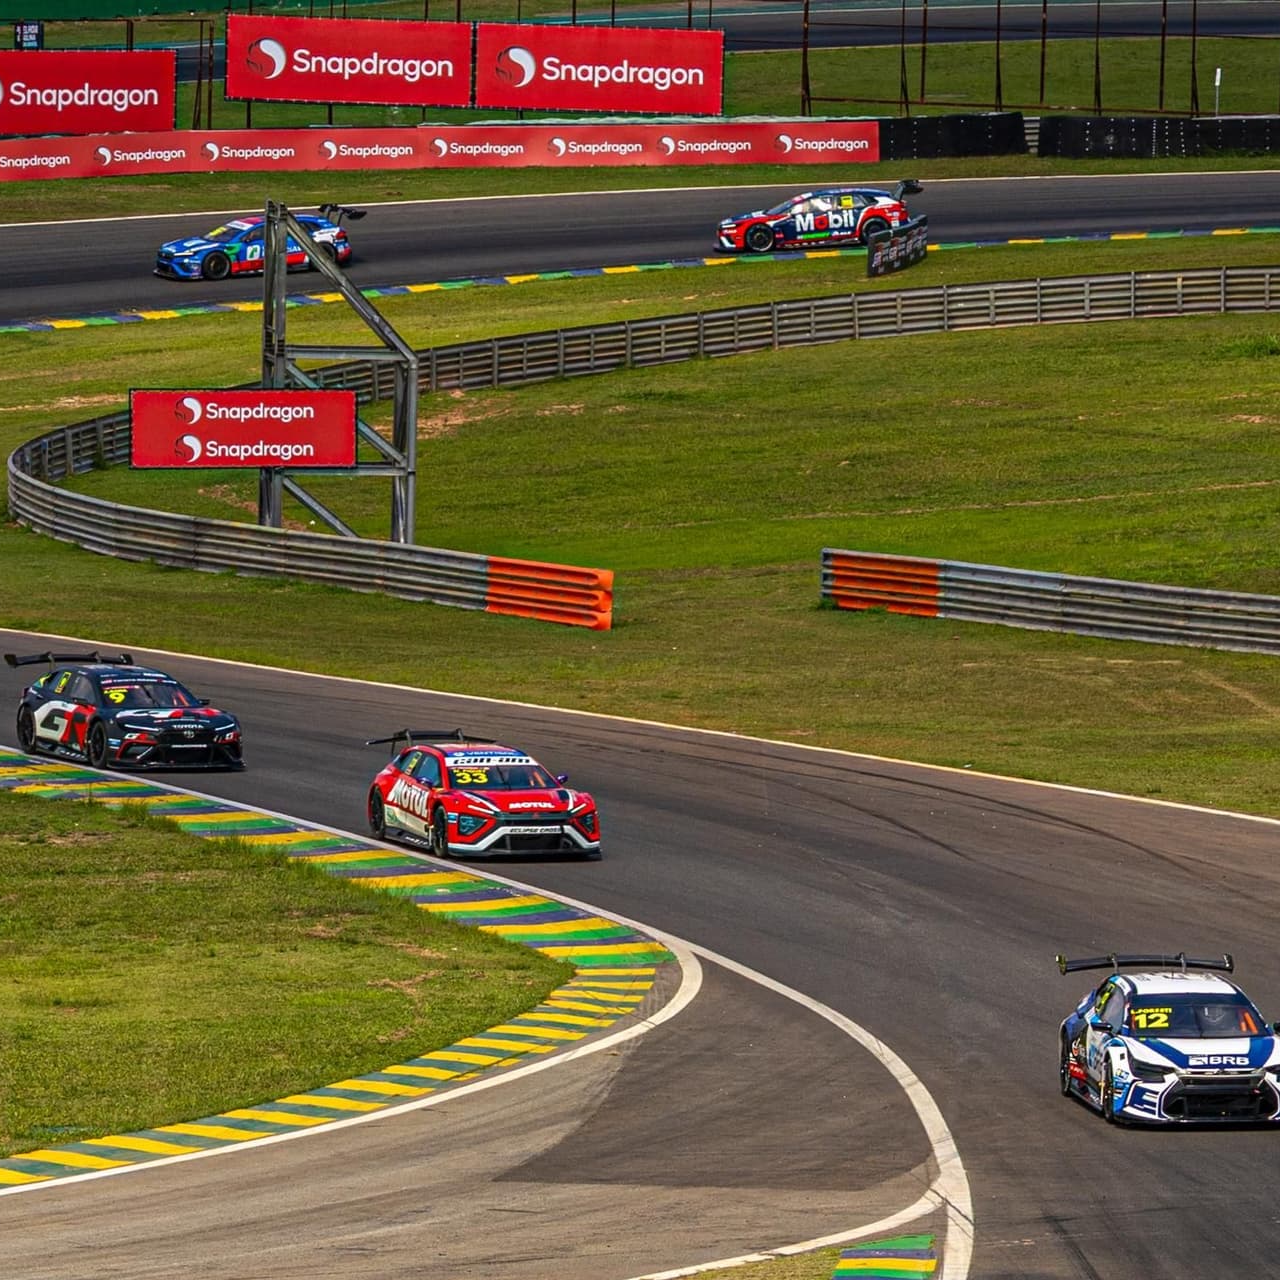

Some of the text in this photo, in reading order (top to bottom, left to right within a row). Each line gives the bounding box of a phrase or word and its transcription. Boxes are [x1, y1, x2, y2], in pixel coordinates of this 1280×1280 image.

[293, 49, 453, 82] Snapdragon
[542, 57, 703, 90] Snapdragon
[10, 82, 158, 111] Snapdragon
[339, 144, 413, 158] Snapdragon
[450, 142, 524, 156] Snapdragon
[568, 141, 642, 155] Snapdragon
[677, 140, 751, 154] Snapdragon
[795, 138, 868, 152] Snapdragon
[114, 149, 186, 163] Snapdragon
[221, 146, 295, 160] Snapdragon
[0, 155, 70, 169] Snapdragon
[795, 210, 854, 232] Mobil
[206, 403, 314, 422] Snapdragon
[206, 440, 313, 460] Snapdragon
[109, 692, 126, 704] 9
[456, 772, 489, 784] 33
[386, 778, 430, 819] MOTUL
[508, 801, 555, 809] MOTUL
[1135, 1013, 1169, 1029] 12
[1209, 1056, 1250, 1065] BRB
